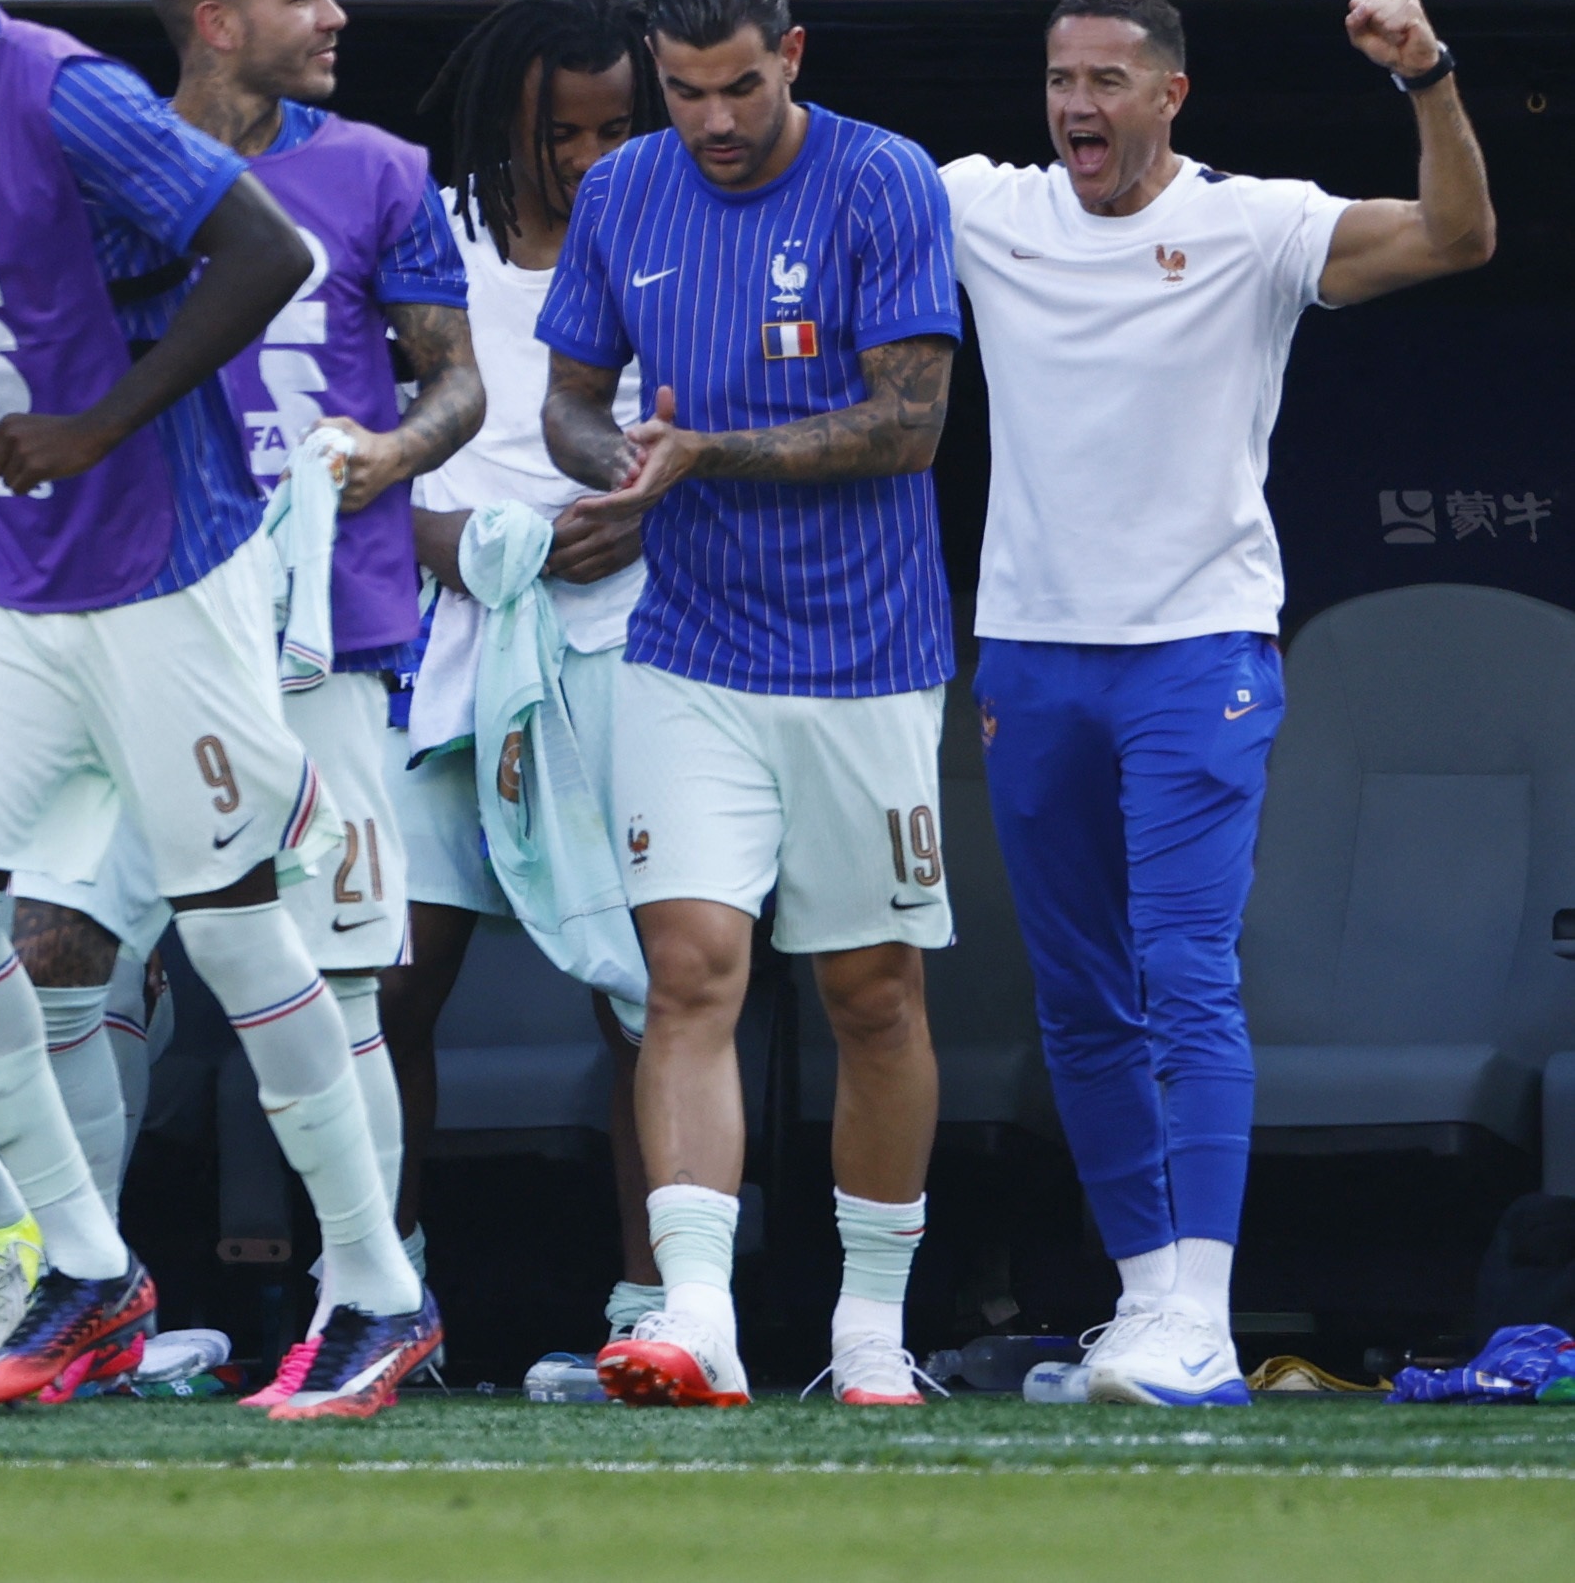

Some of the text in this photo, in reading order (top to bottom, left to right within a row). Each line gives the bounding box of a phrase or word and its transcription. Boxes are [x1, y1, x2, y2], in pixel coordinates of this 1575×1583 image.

[1445, 490, 1556, 543] 蒙牛
[193, 734, 241, 815] 9
[333, 818, 384, 904] 21
[885, 804, 942, 887] 19
